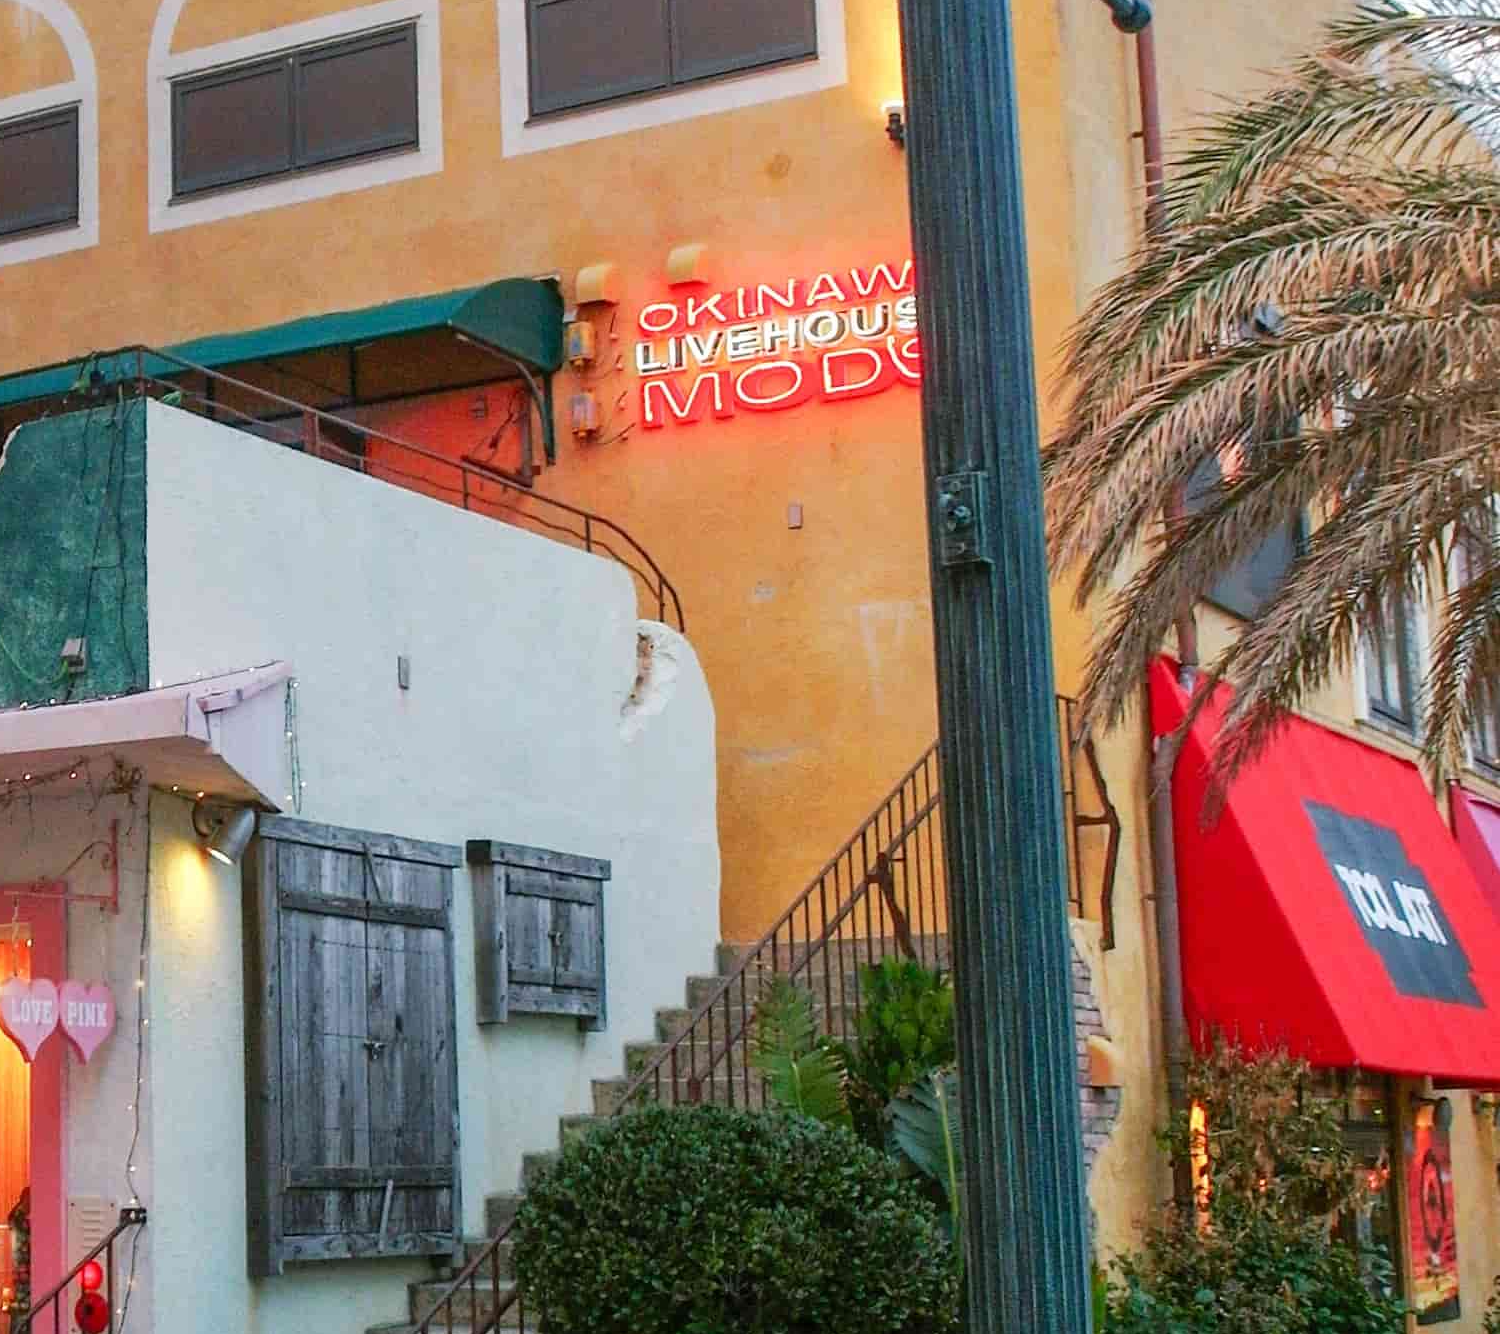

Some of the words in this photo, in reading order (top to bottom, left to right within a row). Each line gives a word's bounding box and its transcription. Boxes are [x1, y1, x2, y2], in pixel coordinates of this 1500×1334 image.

[638, 259, 913, 333] OKINAW
[635, 294, 917, 376] LIVEHOUS
[11, 997, 53, 1025] LOVE
[67, 1001, 107, 1028] PINK
